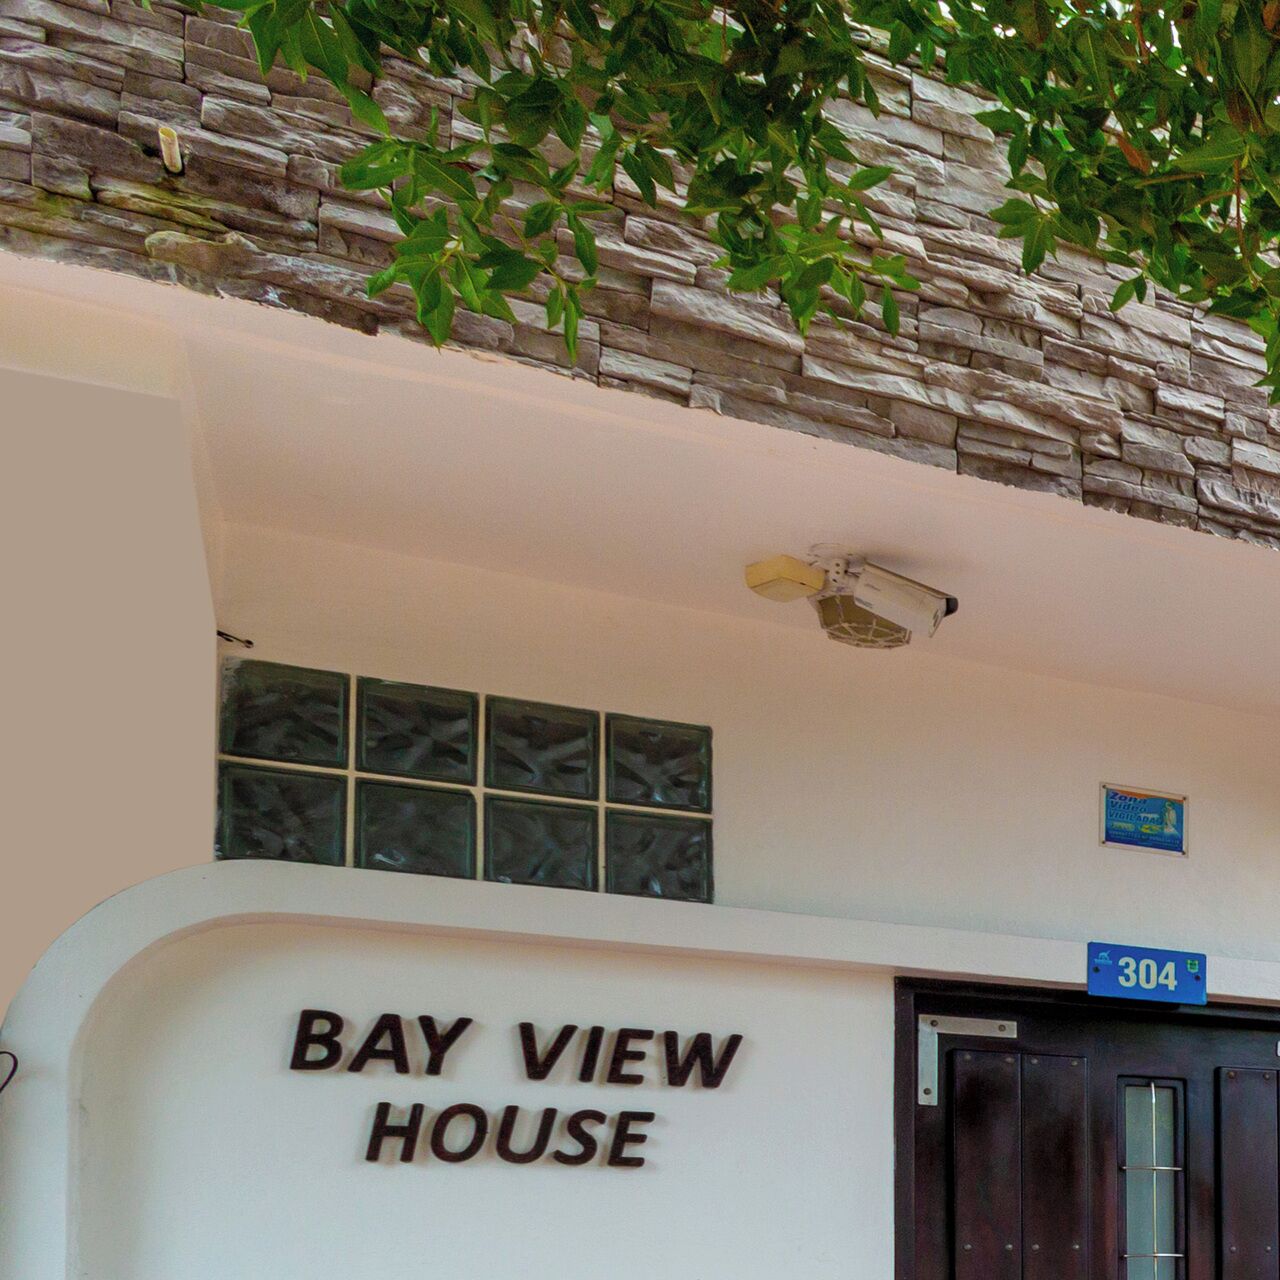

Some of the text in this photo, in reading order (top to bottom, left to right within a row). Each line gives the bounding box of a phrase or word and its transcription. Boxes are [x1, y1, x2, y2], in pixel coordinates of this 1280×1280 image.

[1118, 956, 1178, 992] 304
[290, 1009, 744, 1089] BAY VIEW
[365, 1101, 656, 1168] HOUSE
